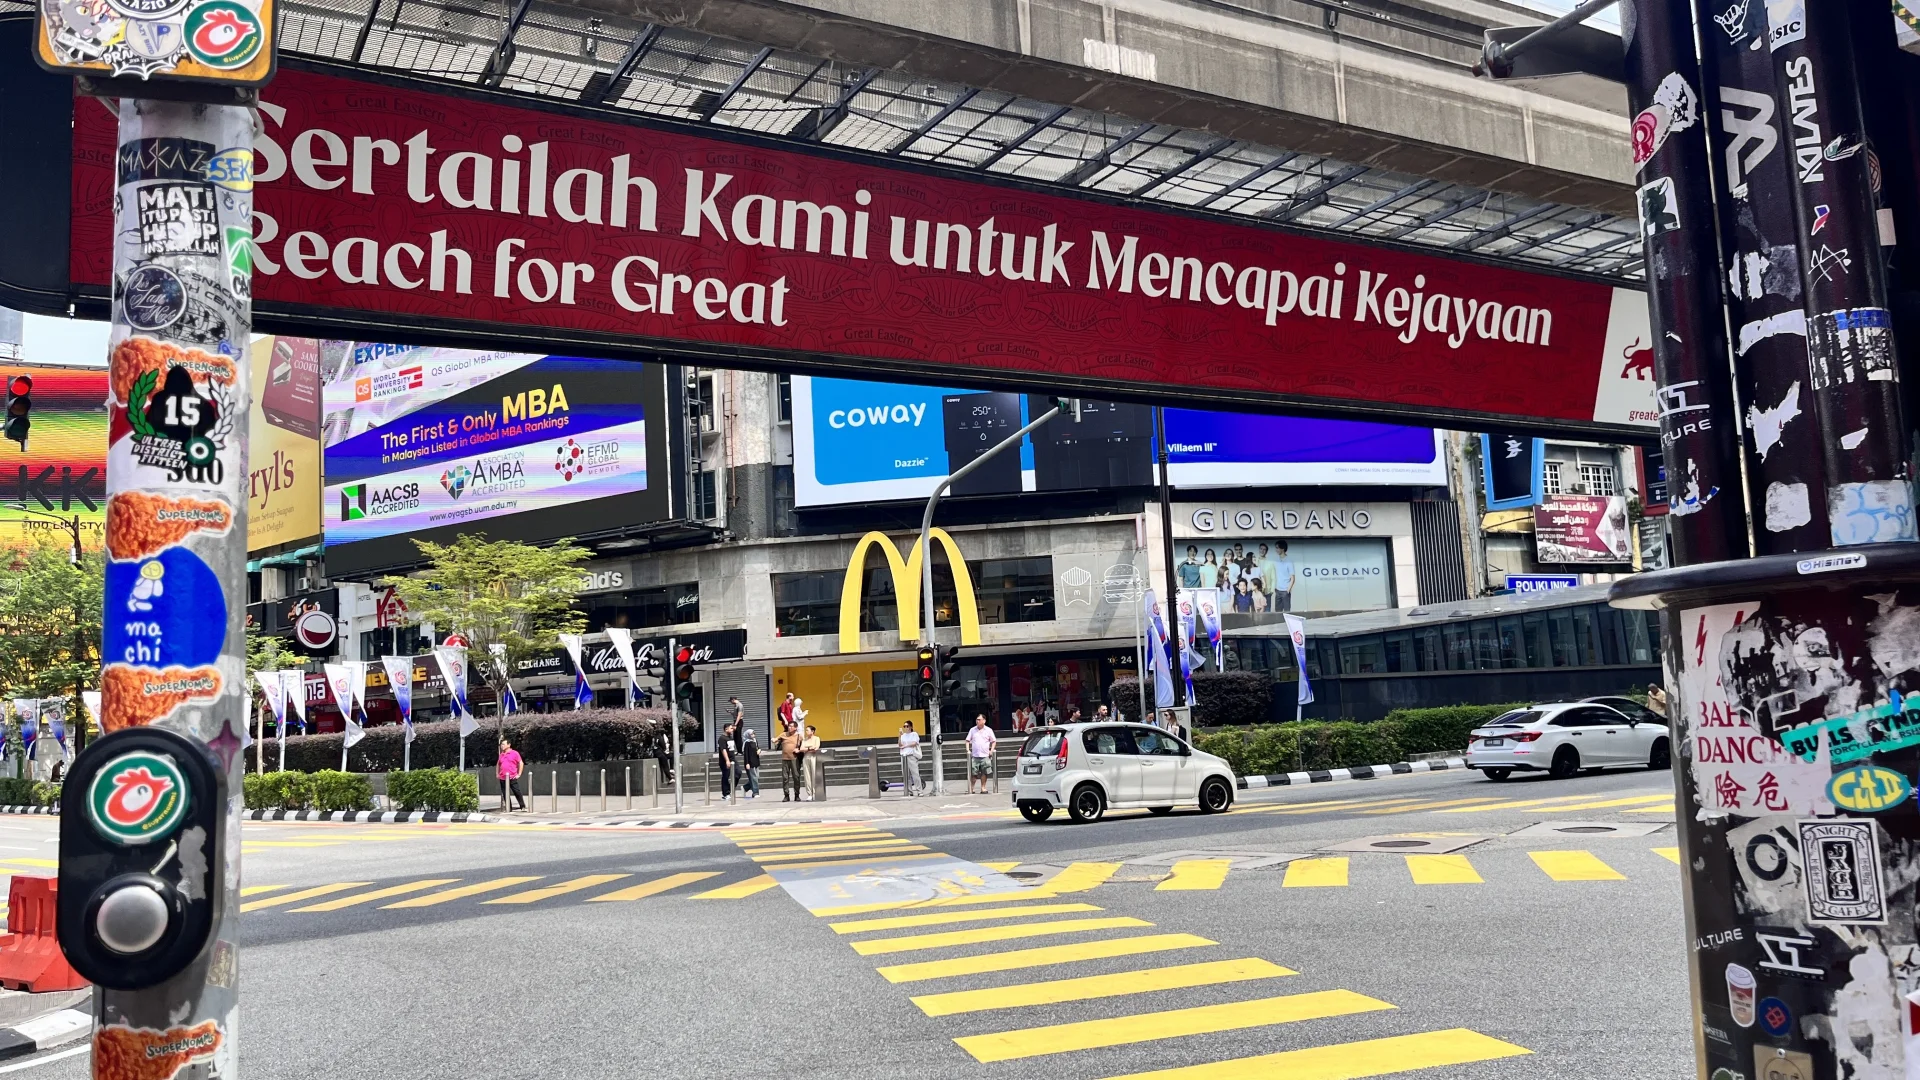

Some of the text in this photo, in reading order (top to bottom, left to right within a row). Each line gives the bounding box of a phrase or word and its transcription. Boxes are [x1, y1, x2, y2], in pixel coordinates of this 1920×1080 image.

[536, 124, 626, 151] Great Eastern
[706, 150, 786, 175] Great Eastern
[253, 101, 1553, 349] Sertailah Kami untuk Mencapai Kejayaan
[253, 210, 790, 327] Reach for Great
[844, 328, 914, 348] Great Eastern
[976, 340, 1041, 359] Great Eastern
[432, 366, 443, 377] QS
[445, 358, 472, 373] Global
[473, 354, 493, 366] MBA
[1097, 353, 1155, 370] Great Eastern
[373, 373, 397, 384] WORLD
[373, 376, 411, 391] UNIVERSITY
[356, 383, 370, 396] QS
[373, 386, 407, 397] RANKINGS
[164, 395, 202, 427] 15
[381, 383, 570, 450] The First & Only MBA
[828, 402, 927, 429] coway
[142, 435, 183, 450] ULTRAS
[382, 416, 570, 464] in Malaysia Listed in Global MBA Rankings
[1167, 442, 1201, 453] Villaem
[133, 443, 188, 461] DISTRICT
[587, 441, 619, 458] EFMD
[140, 454, 188, 471] FIFTEEN
[587, 453, 620, 466] GLOBAL
[249, 449, 295, 510] ryl's
[472, 480, 526, 497] ACCREDITED
[371, 483, 420, 506] AACSB
[370, 499, 420, 516] ACCREDITED
[429, 500, 518, 522] www.oyagsb.uum.edu.my
[1191, 507, 1373, 532] GIORDANO
[1302, 567, 1381, 578] GIORDANO
[125, 621, 163, 638] ma
[1816, 826, 1855, 837] NIGHT
